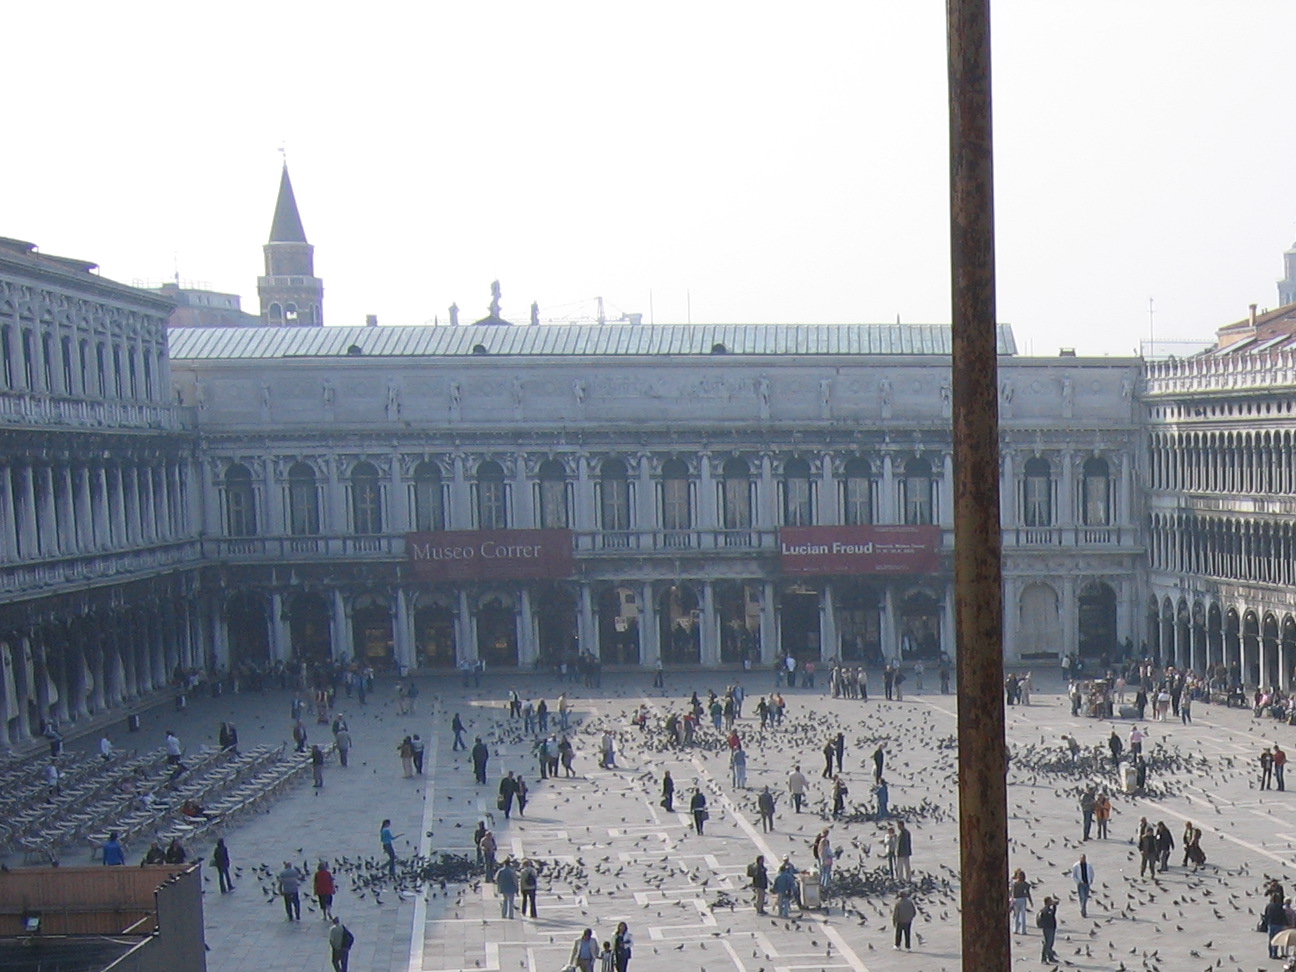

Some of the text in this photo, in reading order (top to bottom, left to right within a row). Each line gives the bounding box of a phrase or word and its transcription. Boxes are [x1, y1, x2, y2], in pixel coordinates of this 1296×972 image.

[412, 541, 542, 560] Museo Correr
[782, 542, 828, 554] Lucian
[832, 541, 873, 553] Freud
